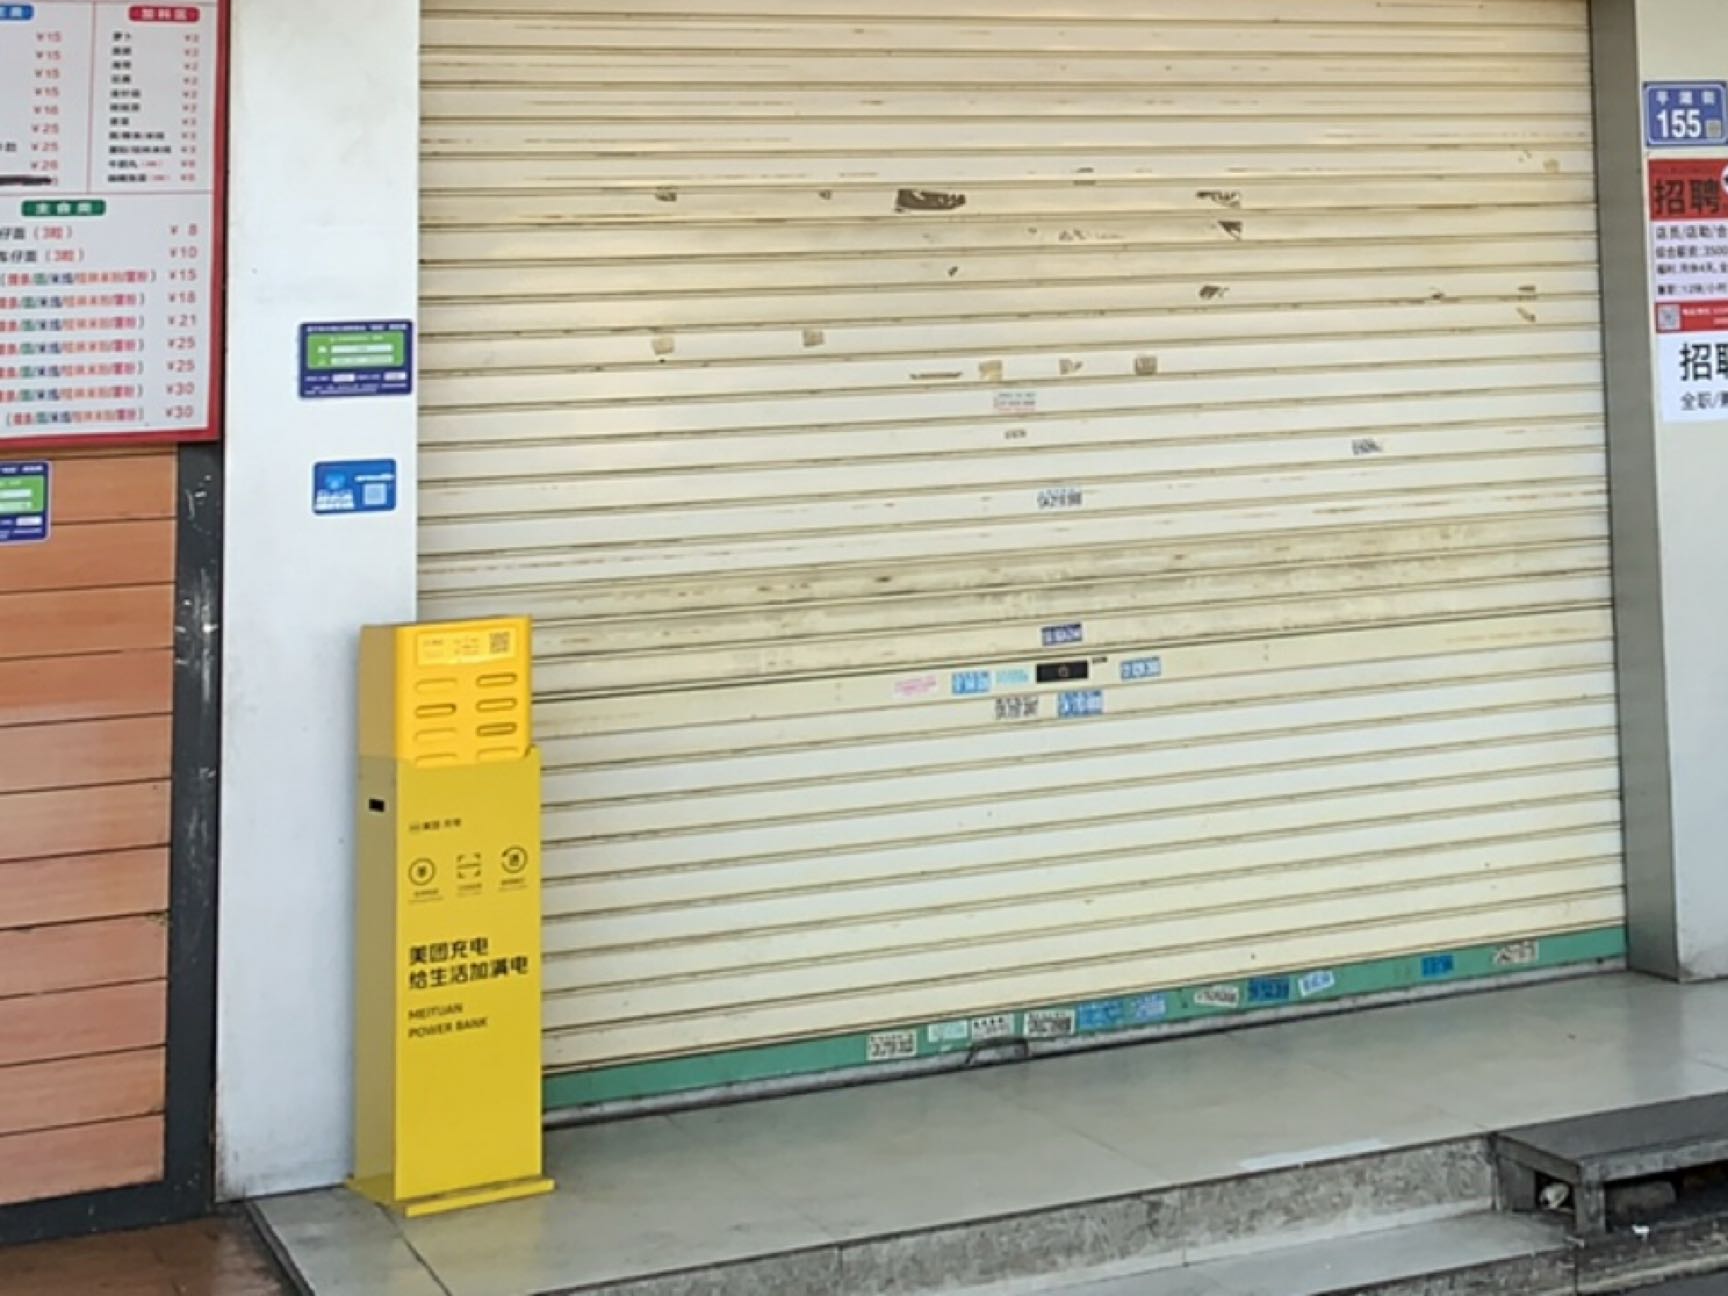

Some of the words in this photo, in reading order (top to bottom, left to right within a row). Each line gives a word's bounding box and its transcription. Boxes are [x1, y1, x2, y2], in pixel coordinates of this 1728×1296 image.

[1656, 109, 1702, 139] 155
[1653, 176, 1722, 215] 招聘
[408, 936, 489, 966] 美团充电
[408, 955, 530, 990] 给生活加满电
[407, 1002, 463, 1021] MEITUAN
[407, 1021, 453, 1039] POWER
[455, 1016, 489, 1033] BANK
